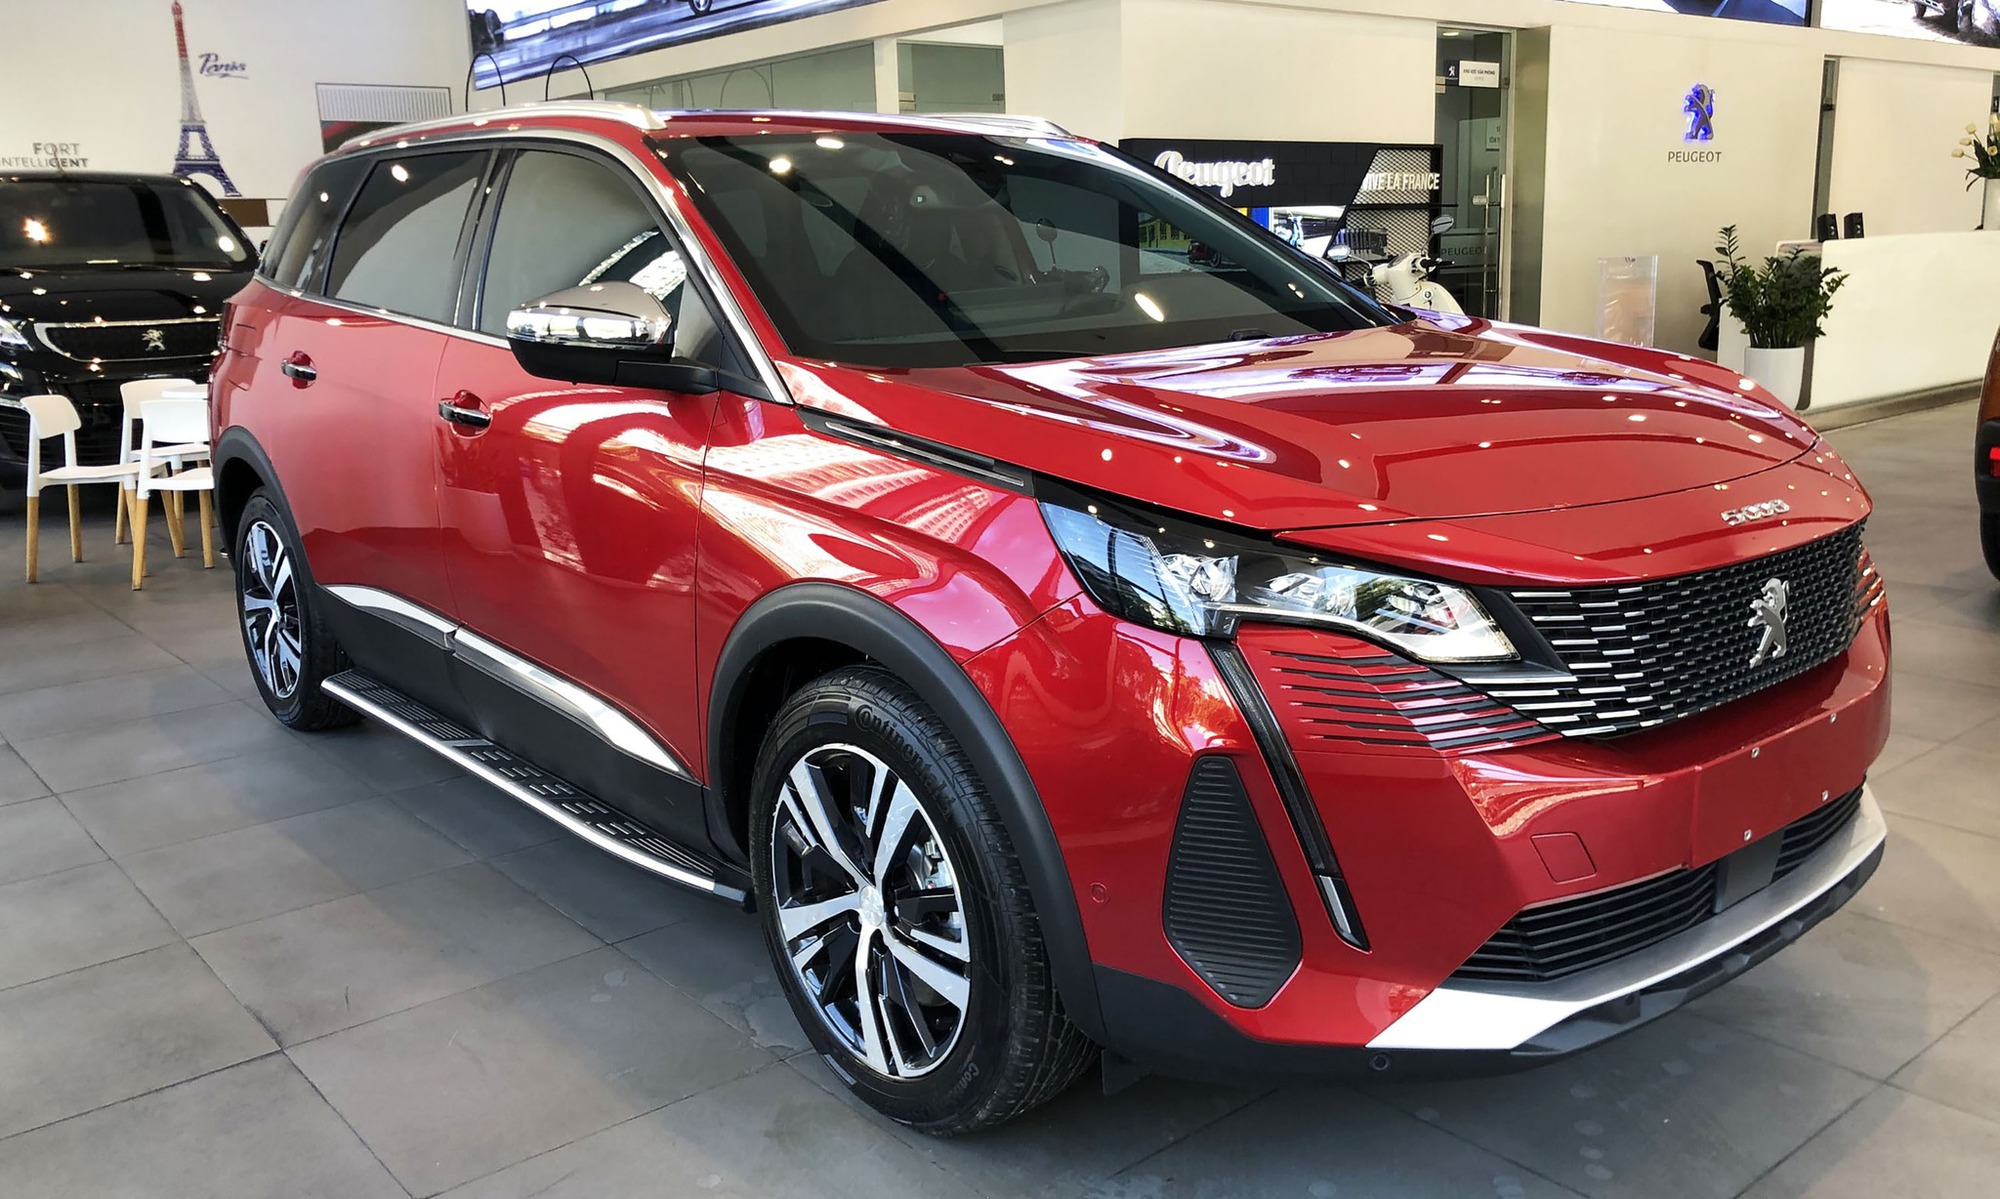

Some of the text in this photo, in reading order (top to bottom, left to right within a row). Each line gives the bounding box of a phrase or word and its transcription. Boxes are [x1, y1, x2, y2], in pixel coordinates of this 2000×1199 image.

[33, 142, 80, 155] FORT
[0, 157, 88, 168] NTELLIGENT
[1668, 151, 1722, 162] PEUGEOT
[1154, 150, 1275, 198] Peugeot
[1387, 172, 1400, 190] LA
[1402, 172, 1440, 190] FRANCE
[1721, 499, 1790, 526] 5008
